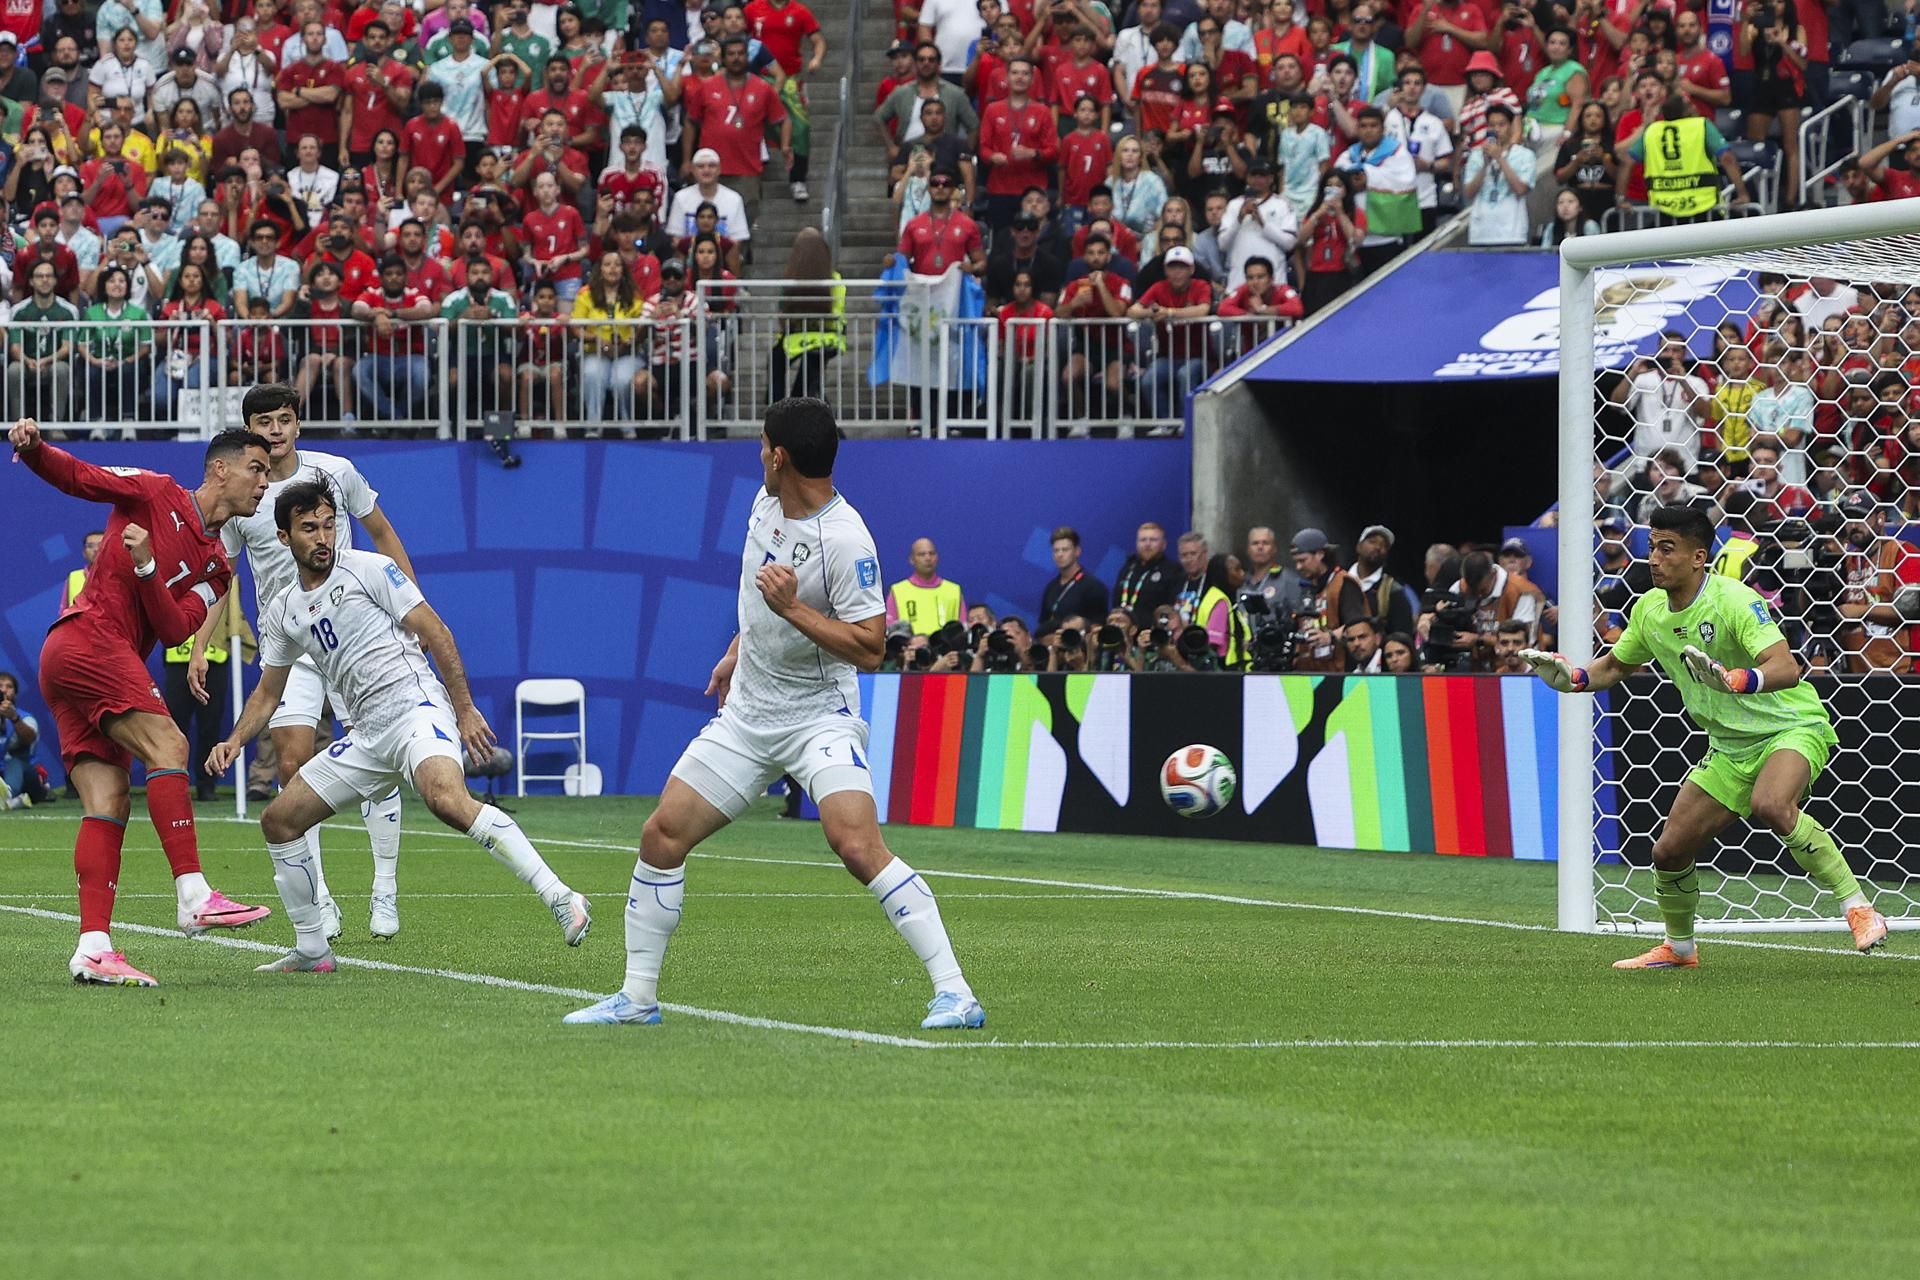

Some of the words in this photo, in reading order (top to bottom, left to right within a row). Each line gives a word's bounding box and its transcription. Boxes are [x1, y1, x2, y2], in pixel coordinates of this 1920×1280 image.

[724, 105, 738, 125] 7
[1652, 175, 1700, 190] ECURITY
[165, 560, 191, 589] 7
[310, 617, 339, 656] 18
